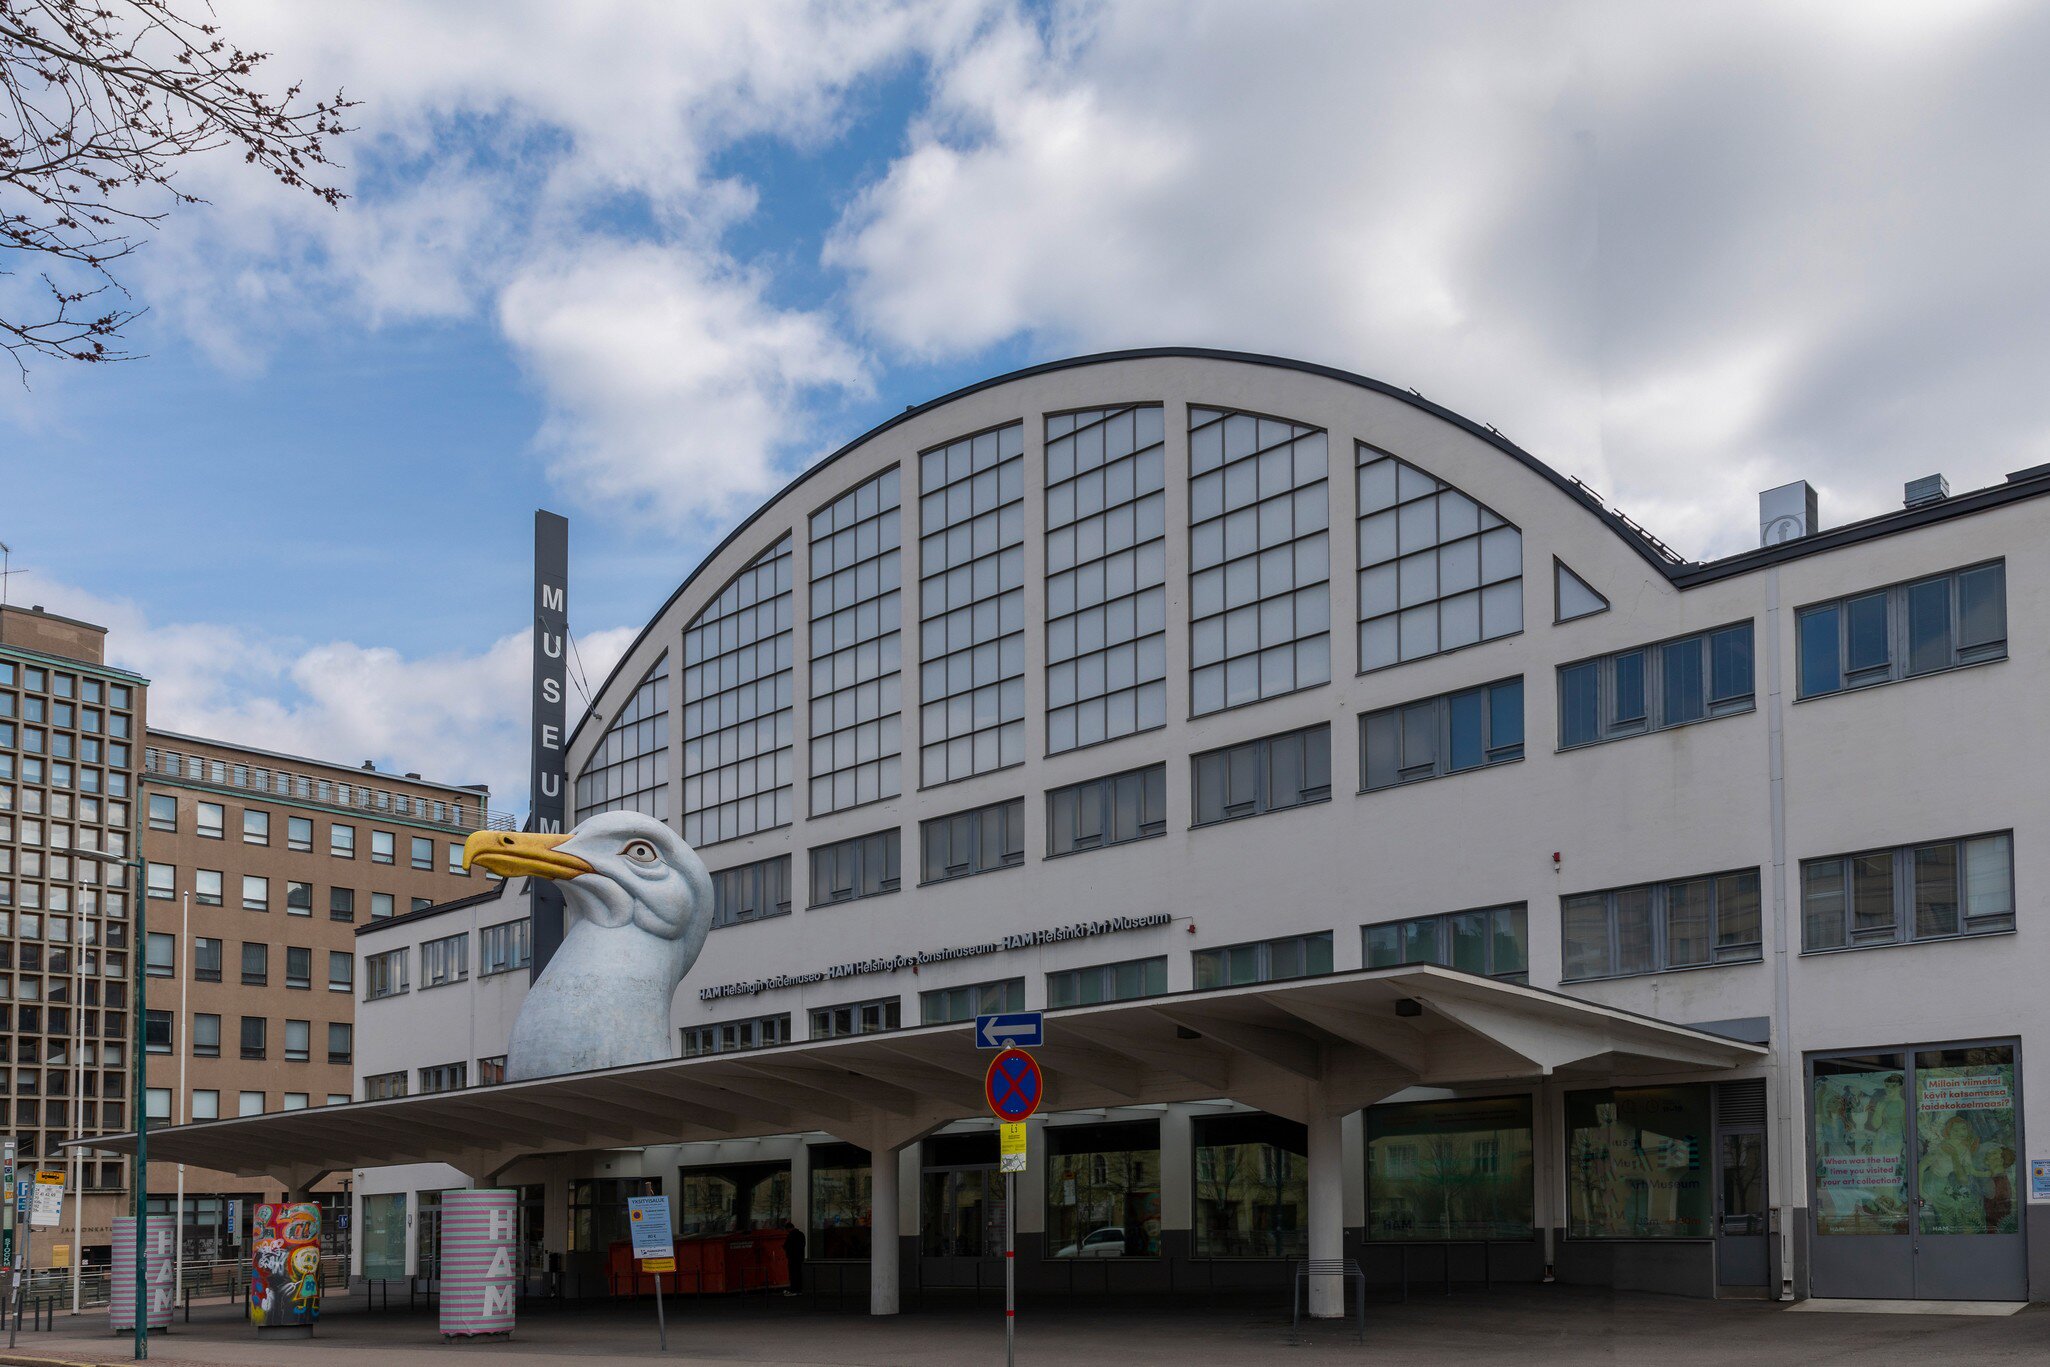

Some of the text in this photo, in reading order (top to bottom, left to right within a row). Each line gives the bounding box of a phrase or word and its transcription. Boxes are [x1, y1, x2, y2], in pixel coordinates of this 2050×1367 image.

[540, 583, 563, 834] MUSEUM
[699, 912, 1170, 1000] HAM Helsingin taidemuseo HAM Helsingfors konstmuseum HAM Helsinki Art Museum
[1929, 1077, 2001, 1088] Milloin viimeksi
[1924, 1089, 2006, 1099] kävit katsomassa
[1920, 1099, 2010, 1111] taidekokoelmaasi?
[1824, 1157, 1847, 1165] When
[1867, 1156, 1881, 1164] the
[1830, 1166, 1893, 1176] time you visited
[1822, 1179, 1840, 1187] your
[1856, 1176, 1902, 1185] collection?
[61, 1226, 112, 1234] JAAONKATU
[483, 1209, 513, 1317] HAM
[153, 1231, 174, 1312] HAM
